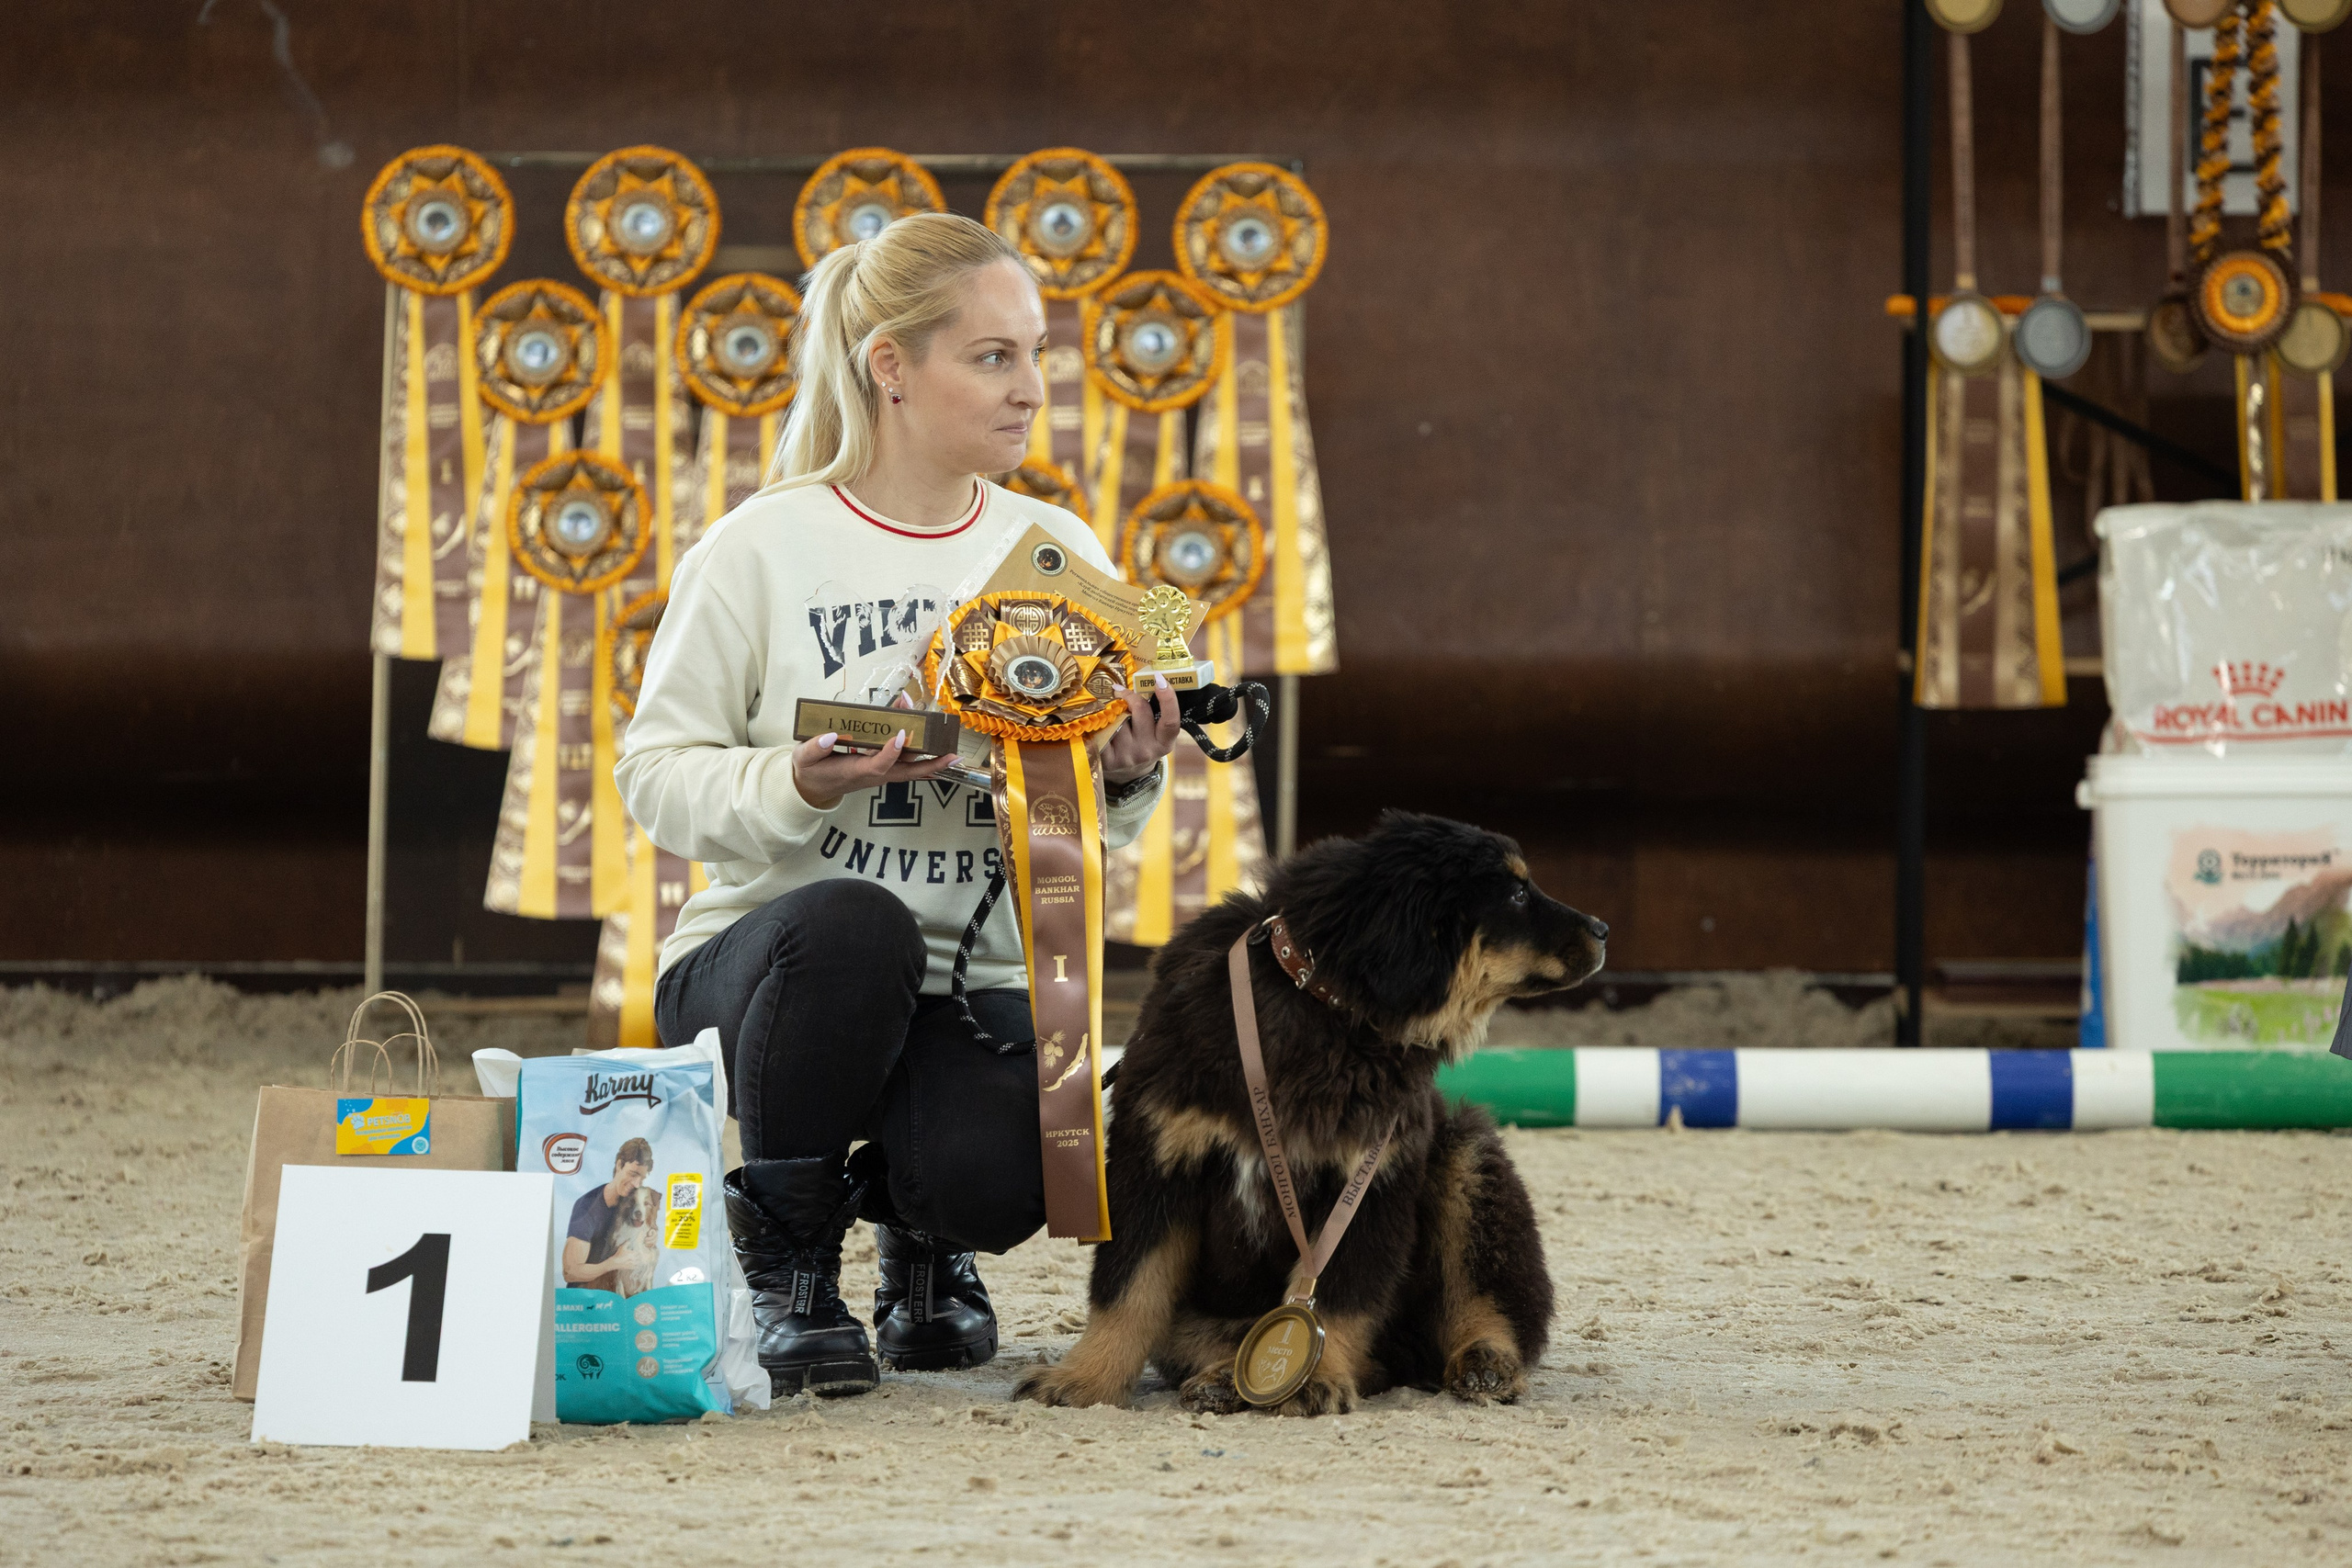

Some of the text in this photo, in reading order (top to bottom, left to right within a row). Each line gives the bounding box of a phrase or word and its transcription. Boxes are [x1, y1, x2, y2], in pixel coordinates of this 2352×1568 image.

[1139, 675, 1193, 688] ПЕРВ ЫСТАВКА
[2154, 699, 2348, 730] ROYAL CANIN
[827, 717, 891, 735] 1 МЕСТО
[820, 826, 1001, 884] UNIVERS
[1036, 875, 1077, 885] MONGOL
[1035, 885, 1080, 895] BANKHAR
[1041, 896, 1075, 905] RUSSIA
[582, 1073, 659, 1110] Karmy
[1253, 1087, 1277, 1147] БАНХАР
[1046, 1128, 1090, 1138] ИРКУТСК
[1057, 1138, 1080, 1147] 2025
[1342, 1140, 1384, 1207] ВЫСТАВК
[794, 1272, 809, 1314] FROSTERR
[366, 1233, 451, 1382] 1
[555, 1323, 620, 1332] ALLERGENIC
